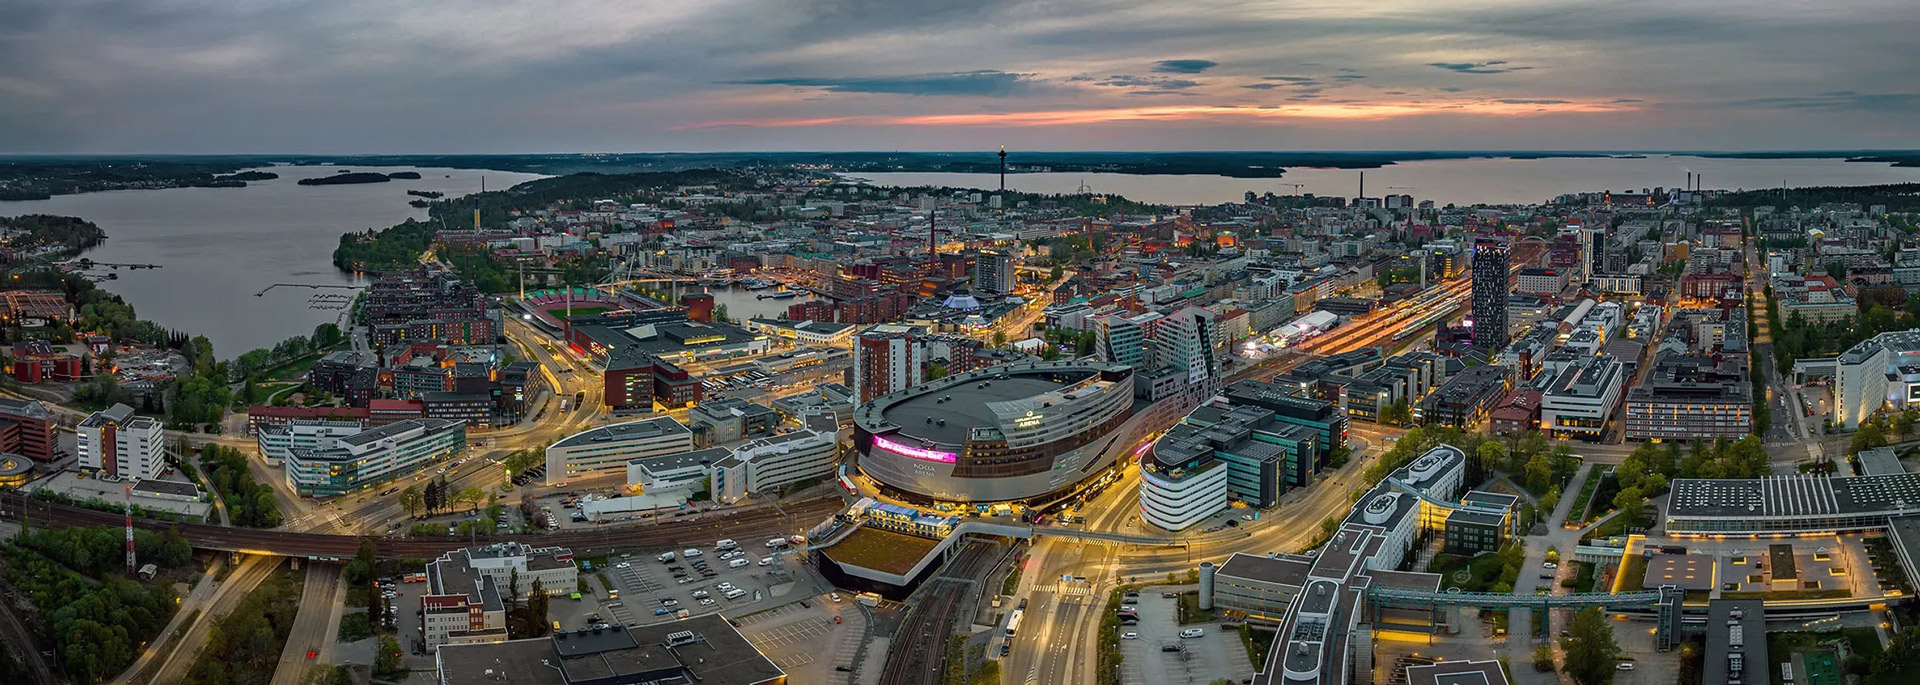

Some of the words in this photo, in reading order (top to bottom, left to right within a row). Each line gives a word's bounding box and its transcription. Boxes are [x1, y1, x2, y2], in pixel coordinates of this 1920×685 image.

[1019, 419, 1040, 428] ARENA
[913, 463, 936, 472] NOKIA
[914, 469, 936, 477] ARENA
